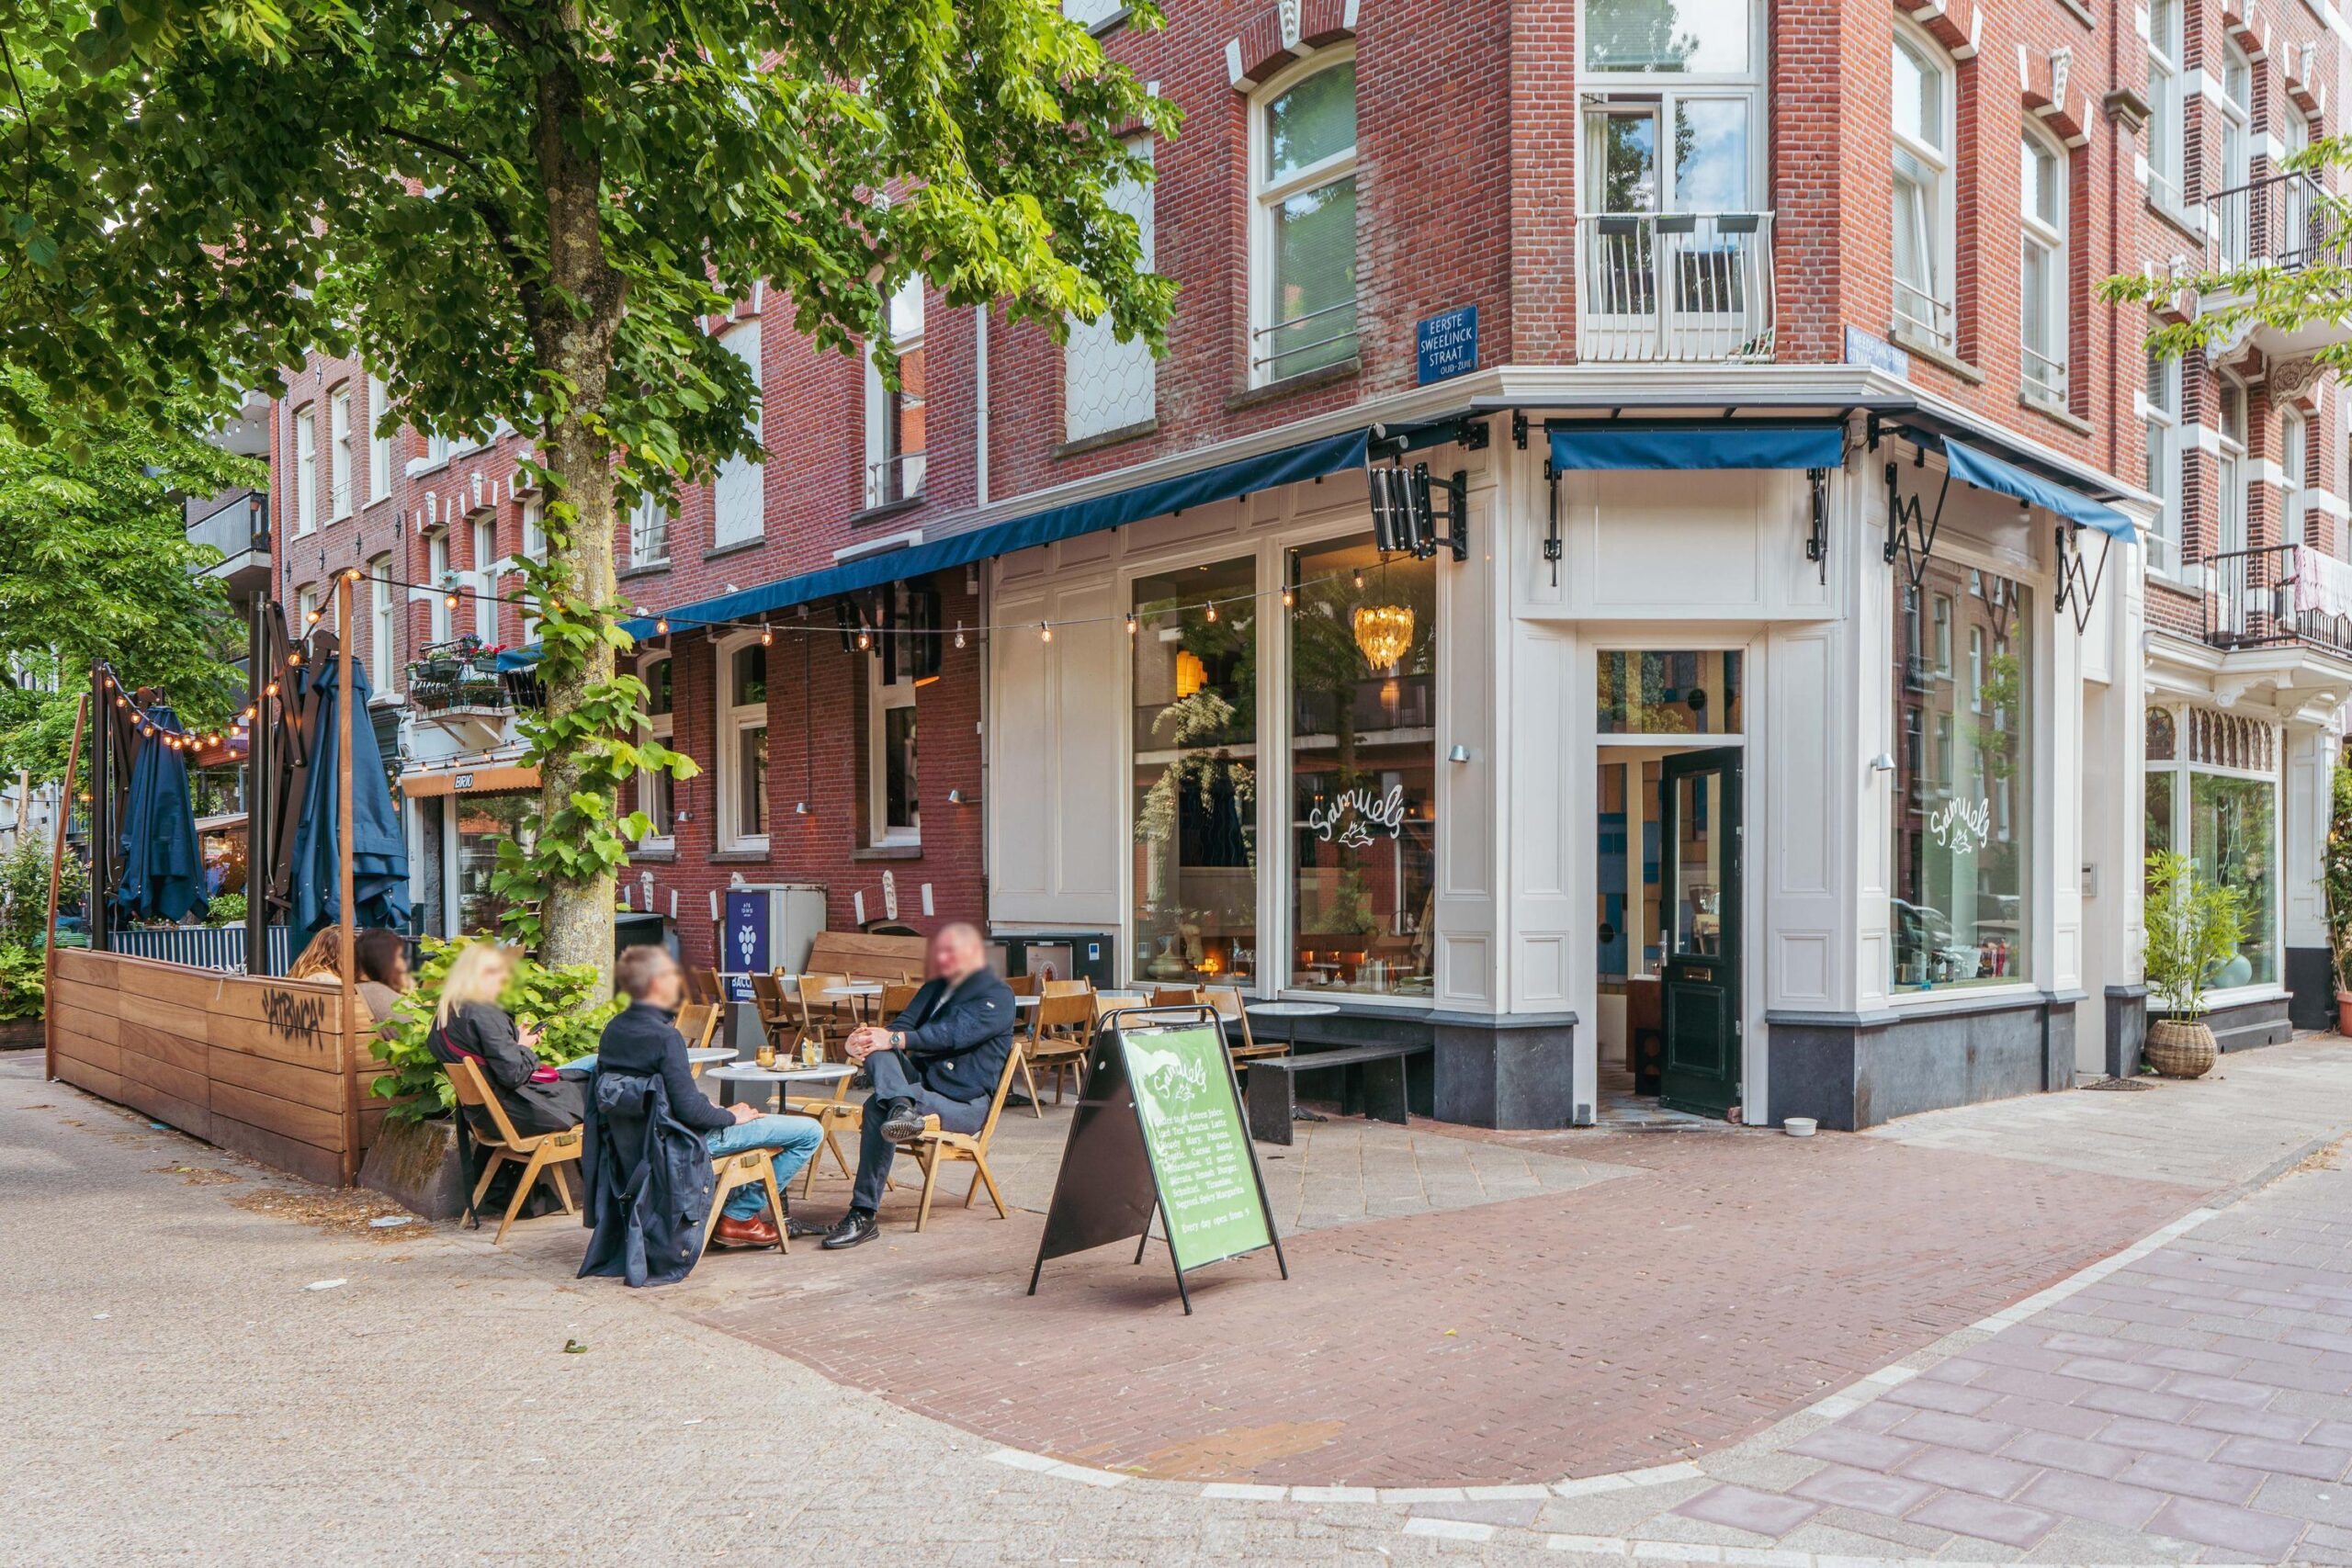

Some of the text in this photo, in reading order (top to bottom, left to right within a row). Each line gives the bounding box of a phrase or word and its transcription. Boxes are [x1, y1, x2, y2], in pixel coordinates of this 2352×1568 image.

[1430, 313, 1463, 334] EERSTE
[1420, 327, 1473, 354] SWEELINCK
[1430, 345, 1464, 367] STRAAT
[455, 773, 473, 788] BRIO
[1182, 1222, 1199, 1234] Every
[1199, 1219, 1212, 1229] day
[1212, 1215, 1227, 1225] open
[1228, 1210, 1243, 1219] from
